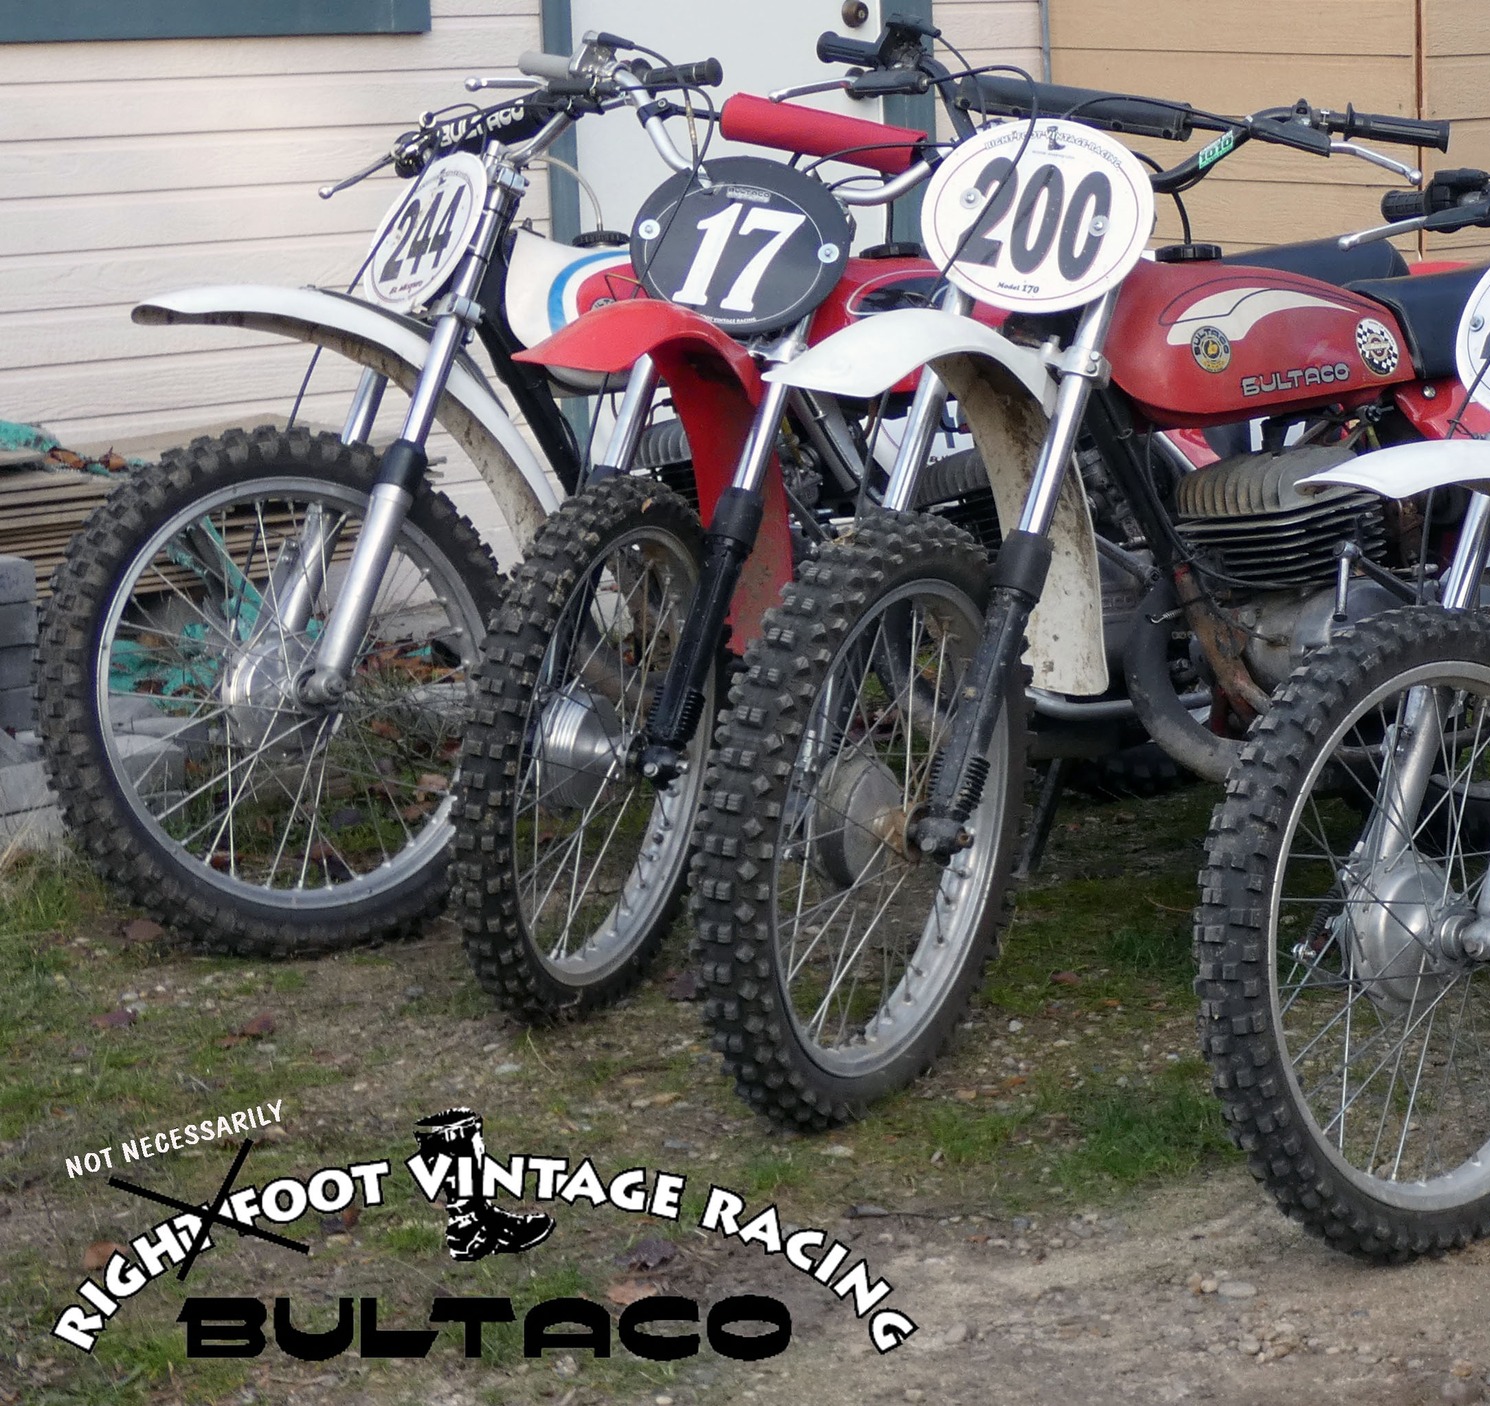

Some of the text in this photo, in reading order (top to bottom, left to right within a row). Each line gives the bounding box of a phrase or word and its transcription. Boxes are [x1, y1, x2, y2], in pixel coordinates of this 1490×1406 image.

[379, 184, 466, 284] 244
[955, 157, 1112, 282] 200
[672, 202, 807, 312] 17
[997, 281, 1020, 291] Model
[1194, 328, 1229, 356] BULTACO
[1240, 362, 1350, 397] BULTACO
